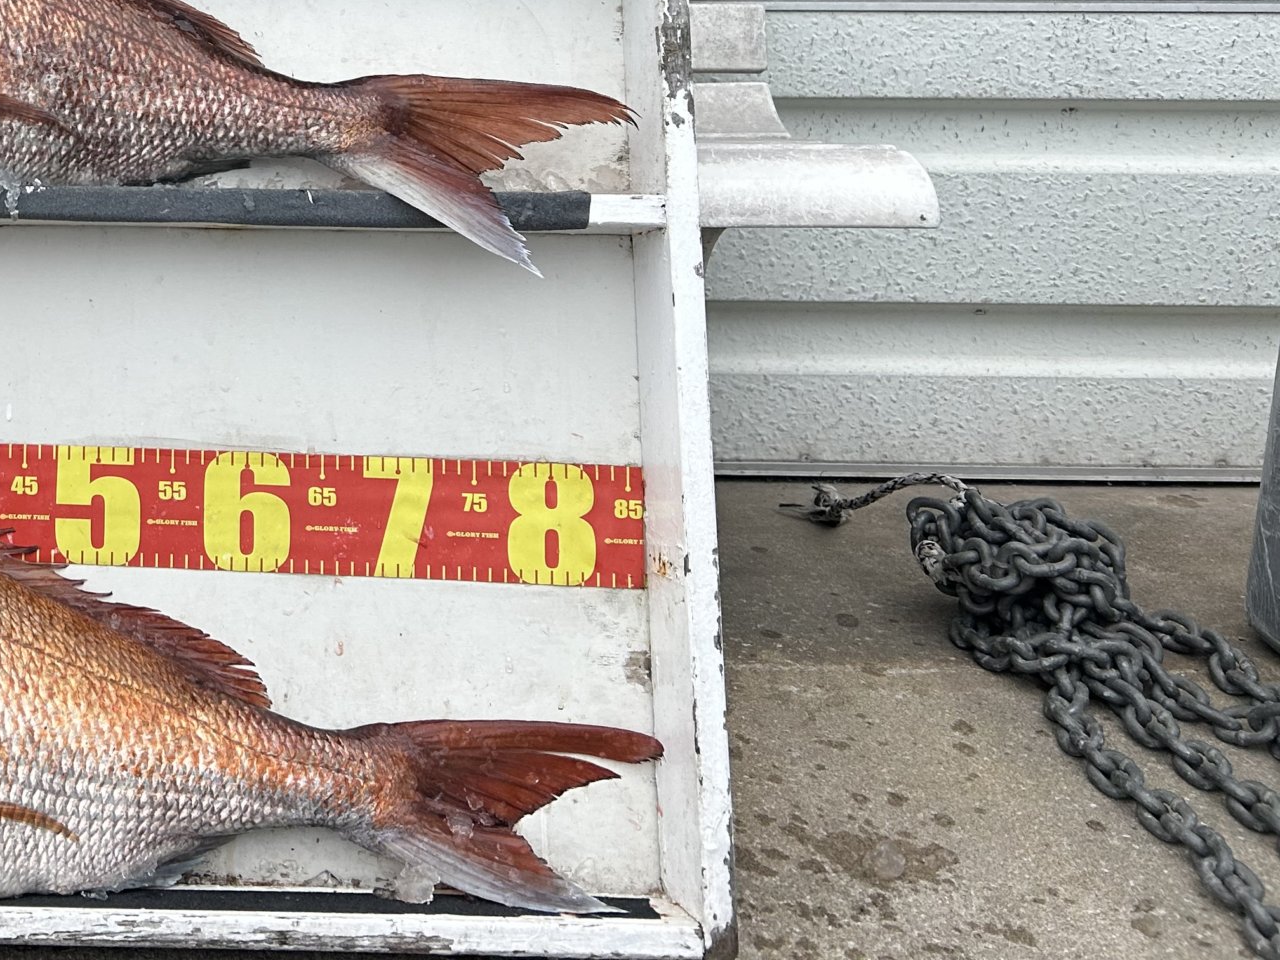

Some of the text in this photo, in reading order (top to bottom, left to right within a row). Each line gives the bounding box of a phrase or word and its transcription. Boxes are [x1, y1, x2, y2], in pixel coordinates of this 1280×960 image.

[8, 513, 32, 521] GLORY
[11, 476, 39, 496] 45
[54, 445, 142, 566] 5
[158, 481, 187, 501] 55
[203, 451, 291, 573] 6
[308, 487, 337, 507] 65
[362, 456, 434, 578] 7
[461, 493, 488, 513] 75
[508, 463, 597, 586] 8
[614, 498, 643, 520] 85
[314, 525, 338, 533] GLORY
[455, 531, 480, 539] GLORY
